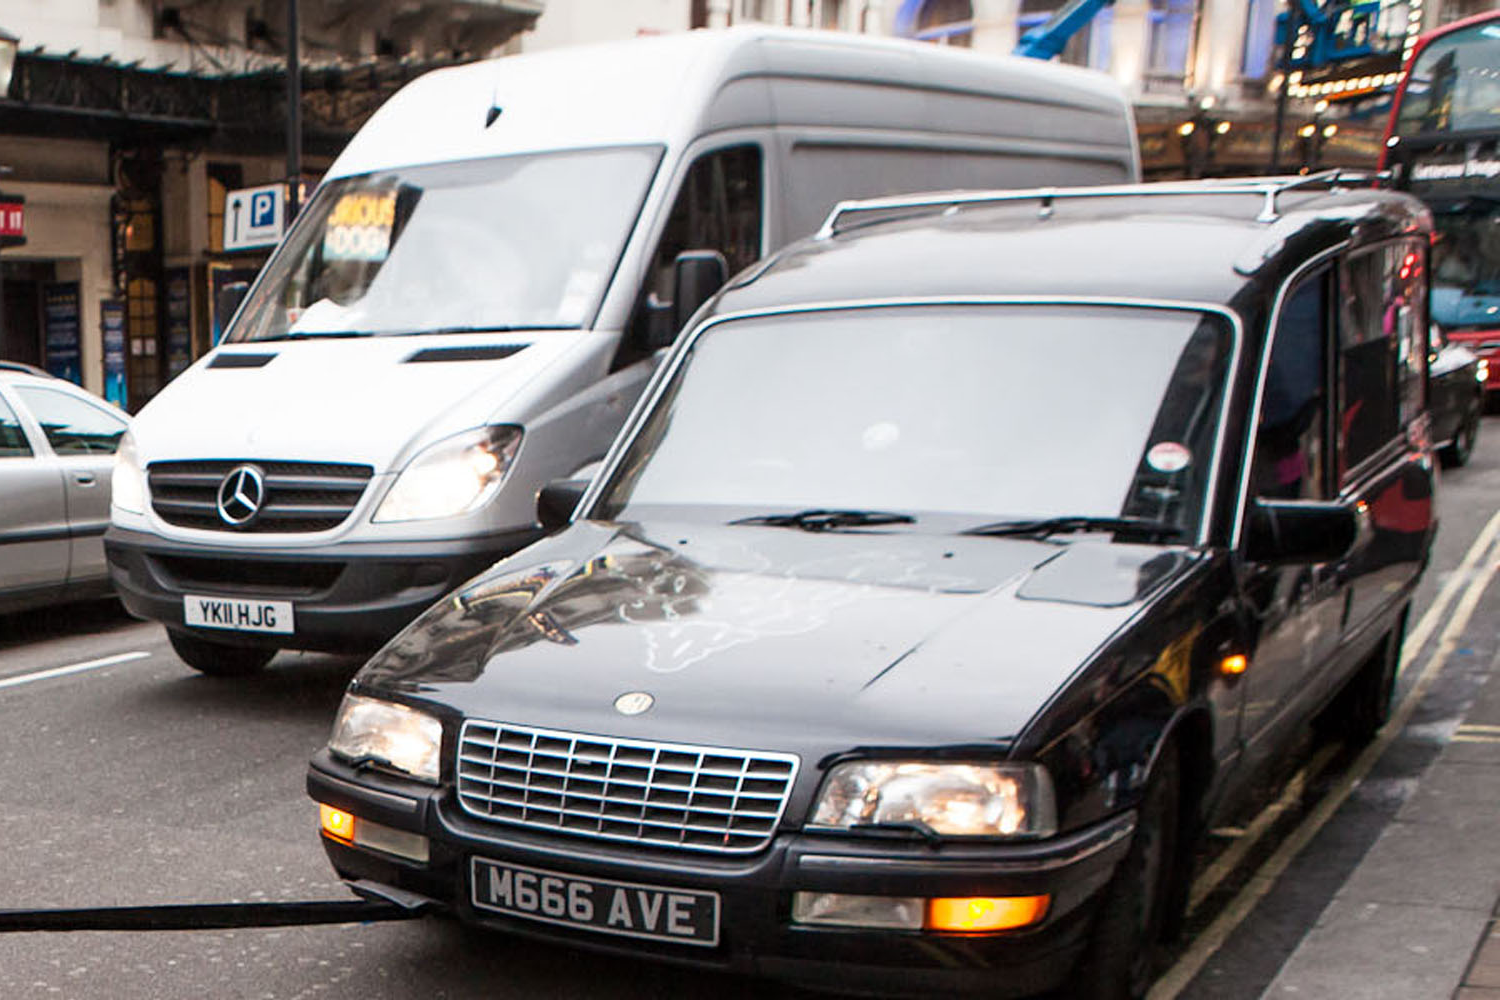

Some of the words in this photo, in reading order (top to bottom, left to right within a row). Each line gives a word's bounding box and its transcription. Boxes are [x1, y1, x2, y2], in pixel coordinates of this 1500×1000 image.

[254, 194, 272, 226] P
[237, 603, 277, 628] HJG
[489, 865, 594, 922] M666
[607, 887, 697, 936] AVE
